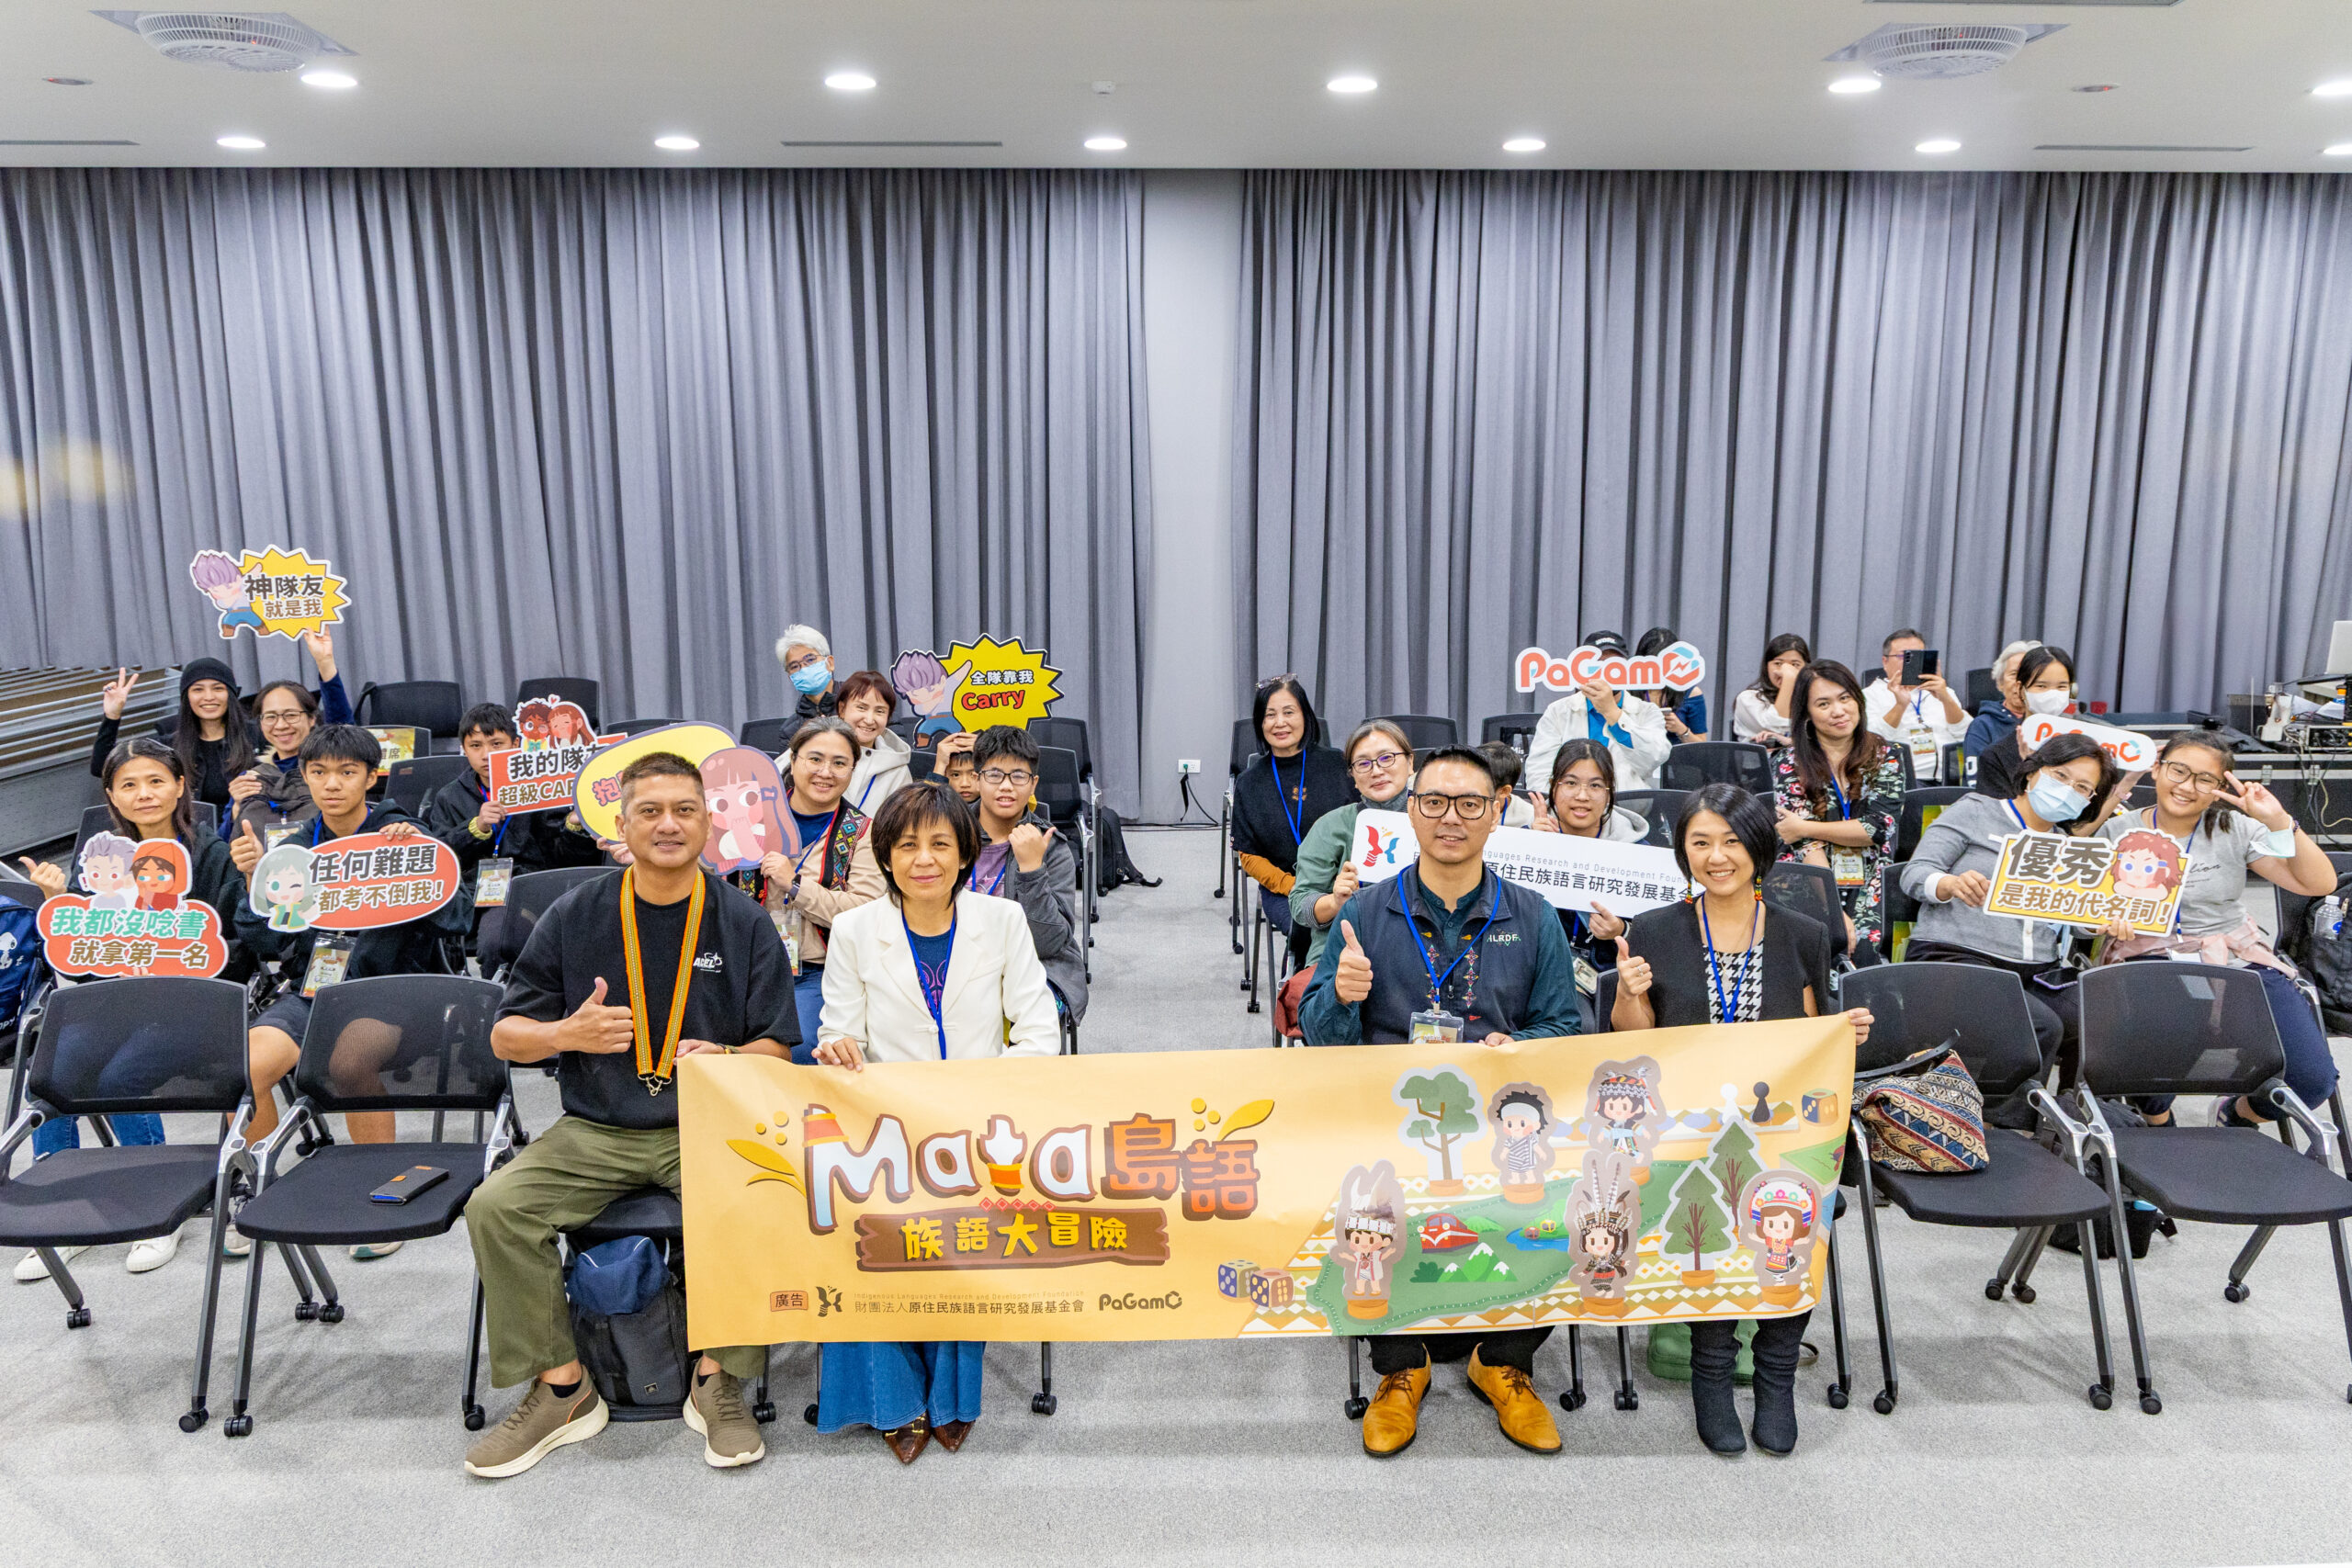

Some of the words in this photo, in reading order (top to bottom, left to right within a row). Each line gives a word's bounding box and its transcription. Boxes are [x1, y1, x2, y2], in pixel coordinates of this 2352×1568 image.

[244, 574, 324, 600] 神隊友
[265, 599, 322, 617] 就是我
[970, 671, 1034, 685] 全隊靠我
[1521, 647, 1700, 687] PaGamO
[961, 690, 1025, 710] Carry
[309, 844, 436, 884] 任何難題
[1525, 853, 1568, 867] Research
[1573, 861, 1589, 871] and
[1594, 864, 1656, 880] Development
[2007, 834, 2110, 885] 優秀
[51, 908, 207, 939] 我都沒唸書
[70, 940, 209, 967] 就拿第一名
[900, 1212, 1128, 1261] 族語大冒險
[775, 1293, 803, 1307] 廣告
[854, 1292, 894, 1301] Indigenous
[992, 1292, 1040, 1301] Development
[1043, 1290, 1084, 1298] Foundation
[854, 1300, 1084, 1314] 財團法人原住民族語言研究發展基金會
[1099, 1291, 1182, 1311] PaGamO
